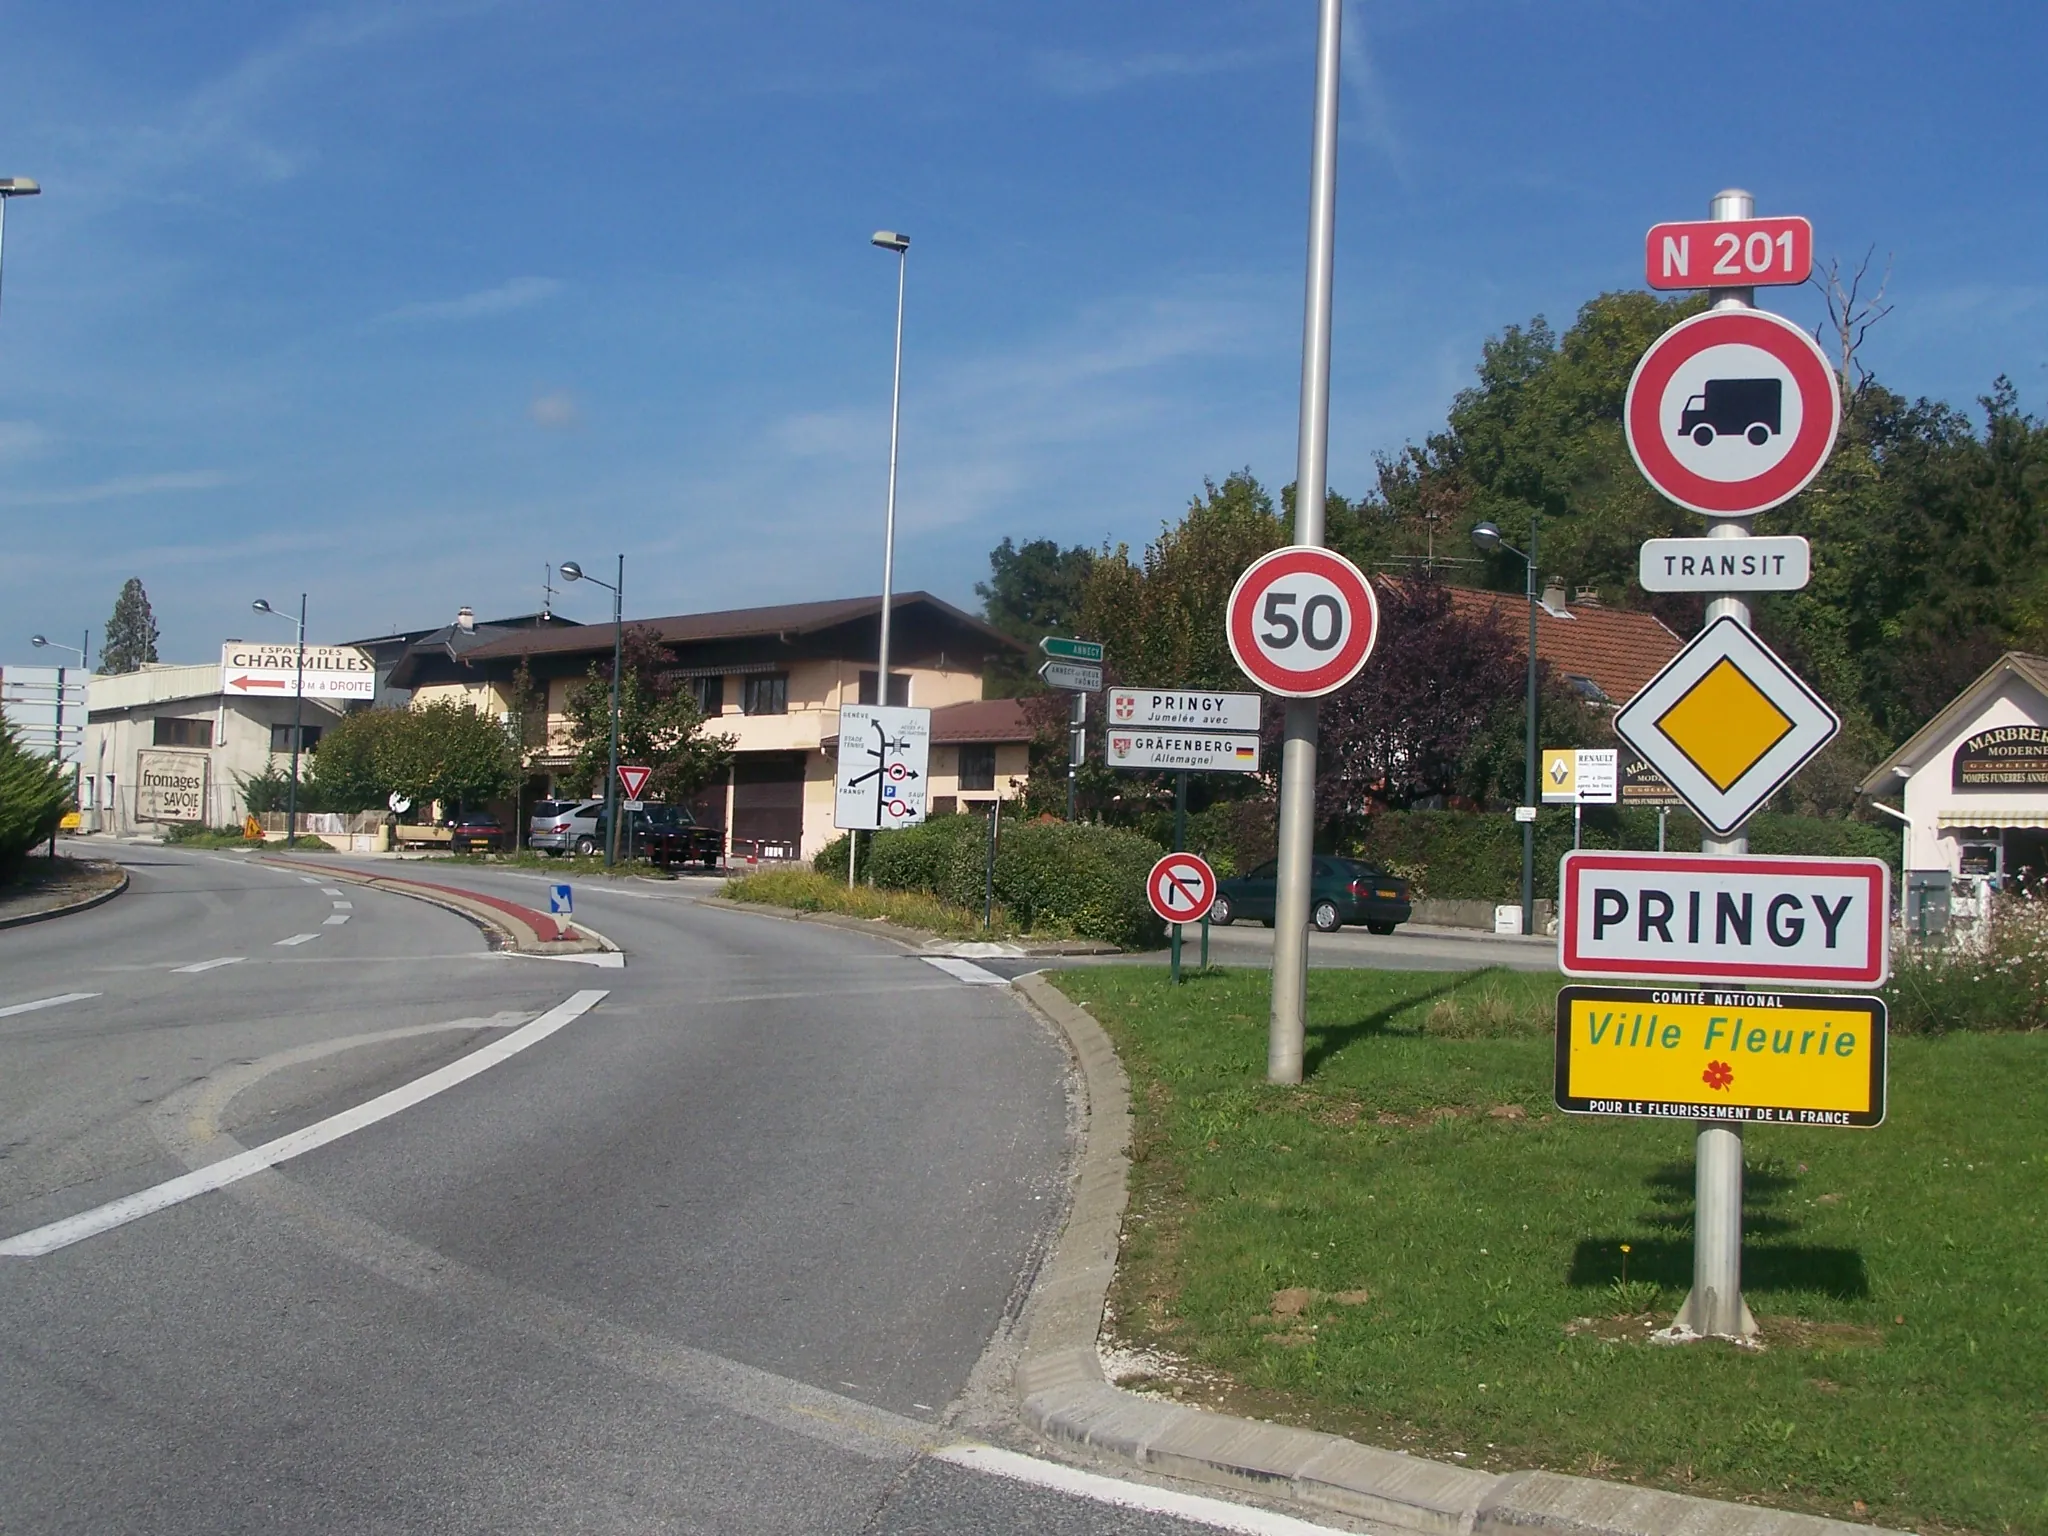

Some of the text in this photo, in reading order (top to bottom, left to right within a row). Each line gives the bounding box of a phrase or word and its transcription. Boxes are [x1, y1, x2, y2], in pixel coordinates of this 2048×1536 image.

[1663, 230, 1793, 277] N 201
[1664, 555, 1785, 576] TRANSIT
[1260, 592, 1343, 651] 50
[260, 646, 342, 656] ESPACE DES
[233, 654, 368, 671] CHARMILLES
[330, 681, 372, 692] DROITE
[1152, 695, 1224, 712] PRINGY
[1148, 712, 1229, 724] Jumelée avec
[1135, 737, 1233, 752] GRÄFENBERG
[1151, 753, 1214, 766] (Allemagne)
[1578, 754, 1613, 762] RENAULT
[143, 769, 200, 792] fromages
[164, 792, 199, 807] SAVOIE
[1593, 889, 1852, 948] PRINGY
[1652, 992, 1783, 1008] COMITÉ NATIONAL
[1589, 1012, 1856, 1057] Ville Fleurie
[1590, 1100, 1850, 1125] POUR LE FLEURISSEMENT DE LA FRANCE
